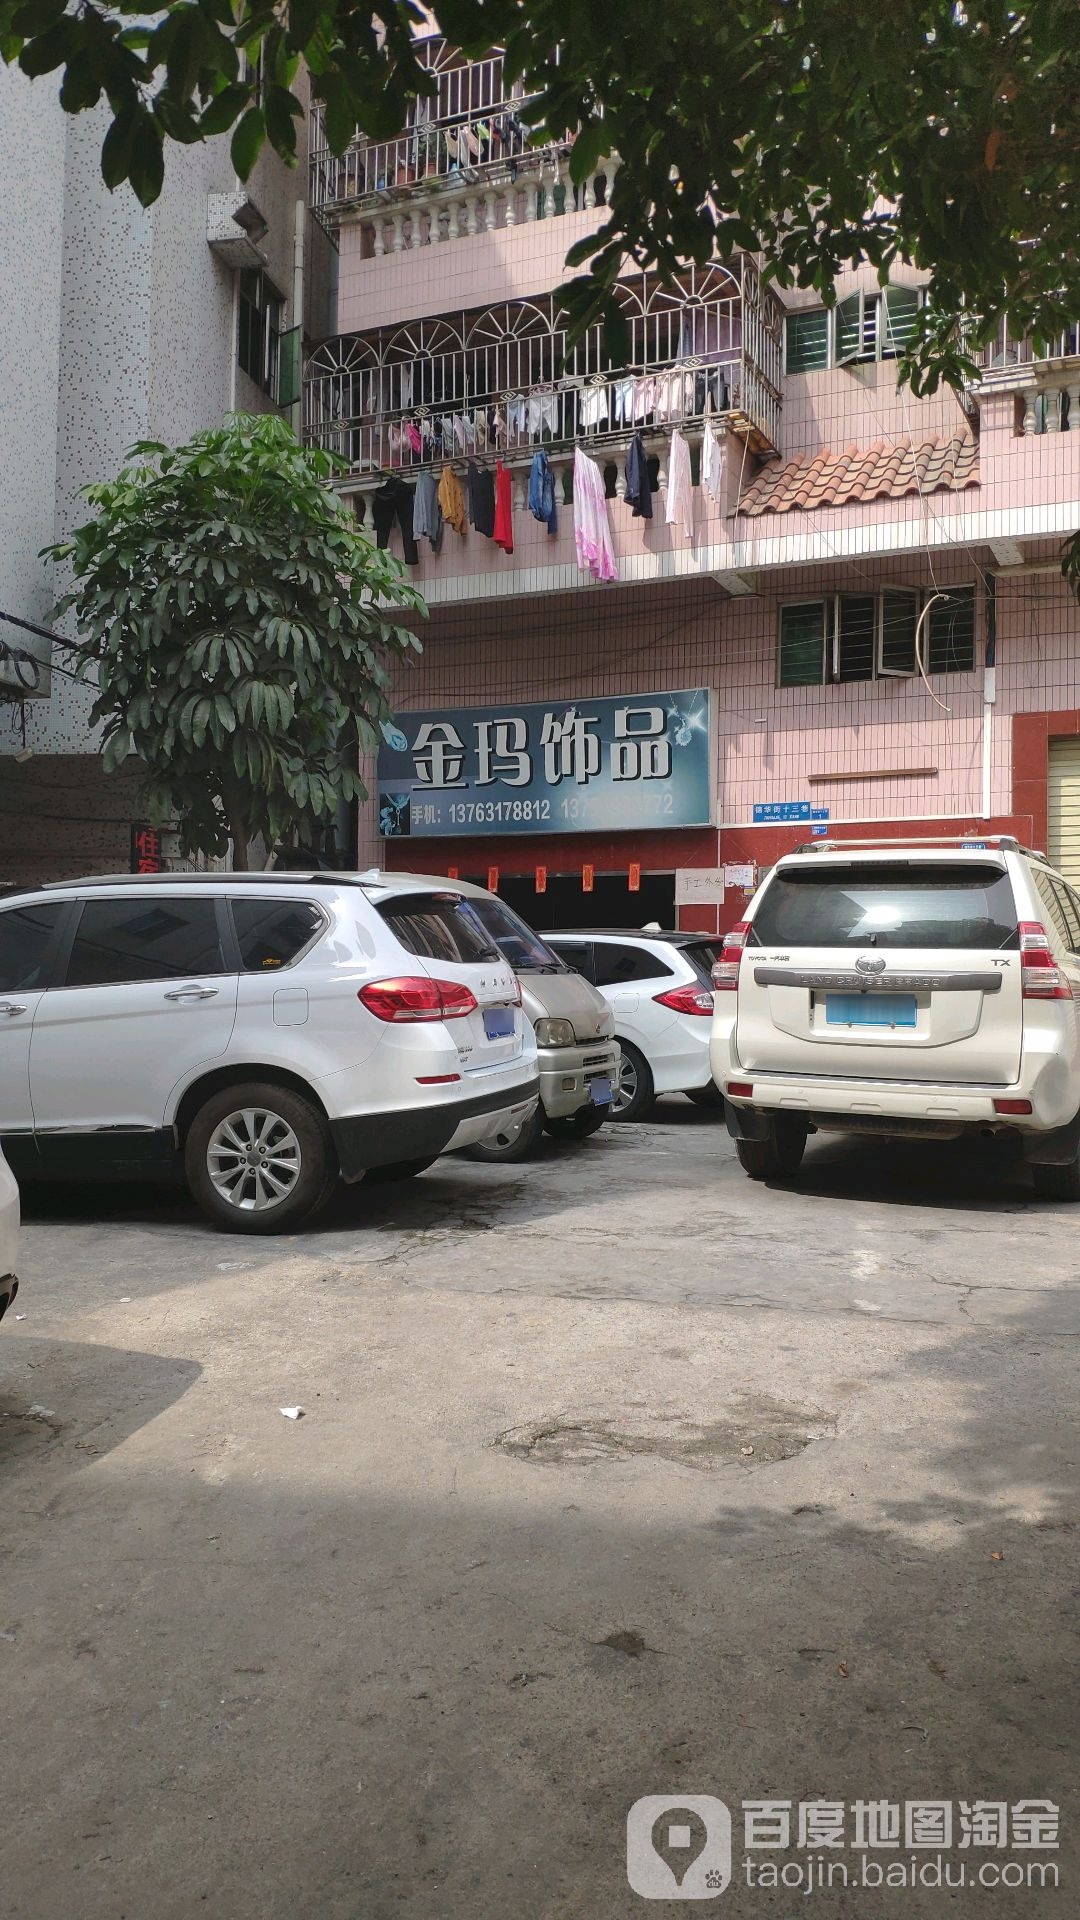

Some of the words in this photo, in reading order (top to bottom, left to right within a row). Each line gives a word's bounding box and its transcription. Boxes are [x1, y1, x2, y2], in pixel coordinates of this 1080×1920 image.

[412, 704, 671, 790] 金玛饰品
[990, 959, 1011, 967] TX
